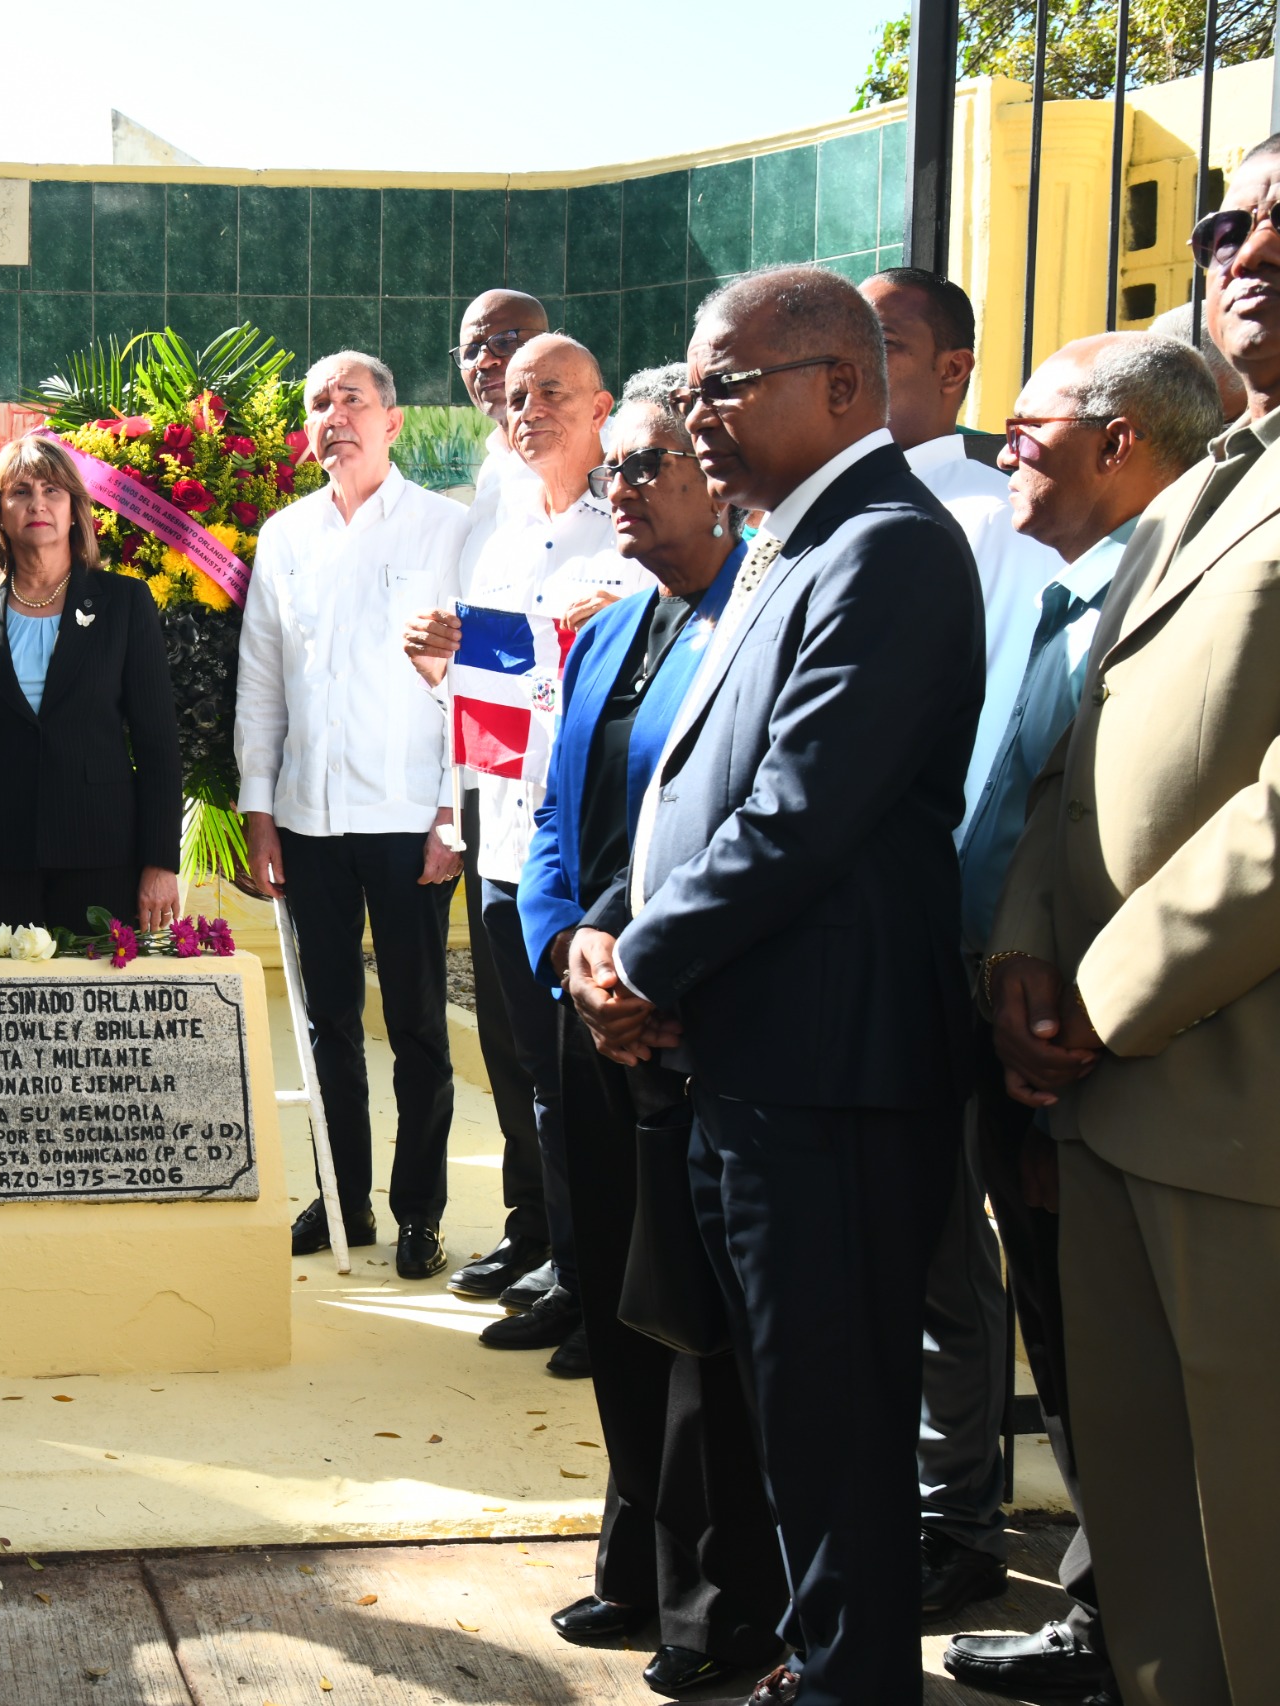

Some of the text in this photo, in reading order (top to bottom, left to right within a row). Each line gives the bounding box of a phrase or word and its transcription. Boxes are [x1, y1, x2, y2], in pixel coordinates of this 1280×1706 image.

[129, 503, 141, 515] DEL
[142, 512, 182, 540] MOVIMIENTO
[182, 538, 221, 574] CAAMANISTA
[138, 494, 151, 507] DEL
[151, 503, 162, 514] VIL
[162, 511, 198, 538] ASESINATO
[198, 536, 228, 564] ORLANDO
[83, 989, 188, 1013] ORLANDO
[95, 1018, 204, 1041] BRILLANTE
[34, 1049, 43, 1069] Y
[53, 1047, 152, 1070] MILITANTE
[72, 1075, 176, 1094] EJEMPLAR
[21, 1106, 50, 1123] SU
[60, 1104, 164, 1122] MEMORIA
[36, 1128, 56, 1144] EL
[63, 1125, 165, 1143] SOCIALISMO
[39, 1147, 148, 1164] DOMINICANO
